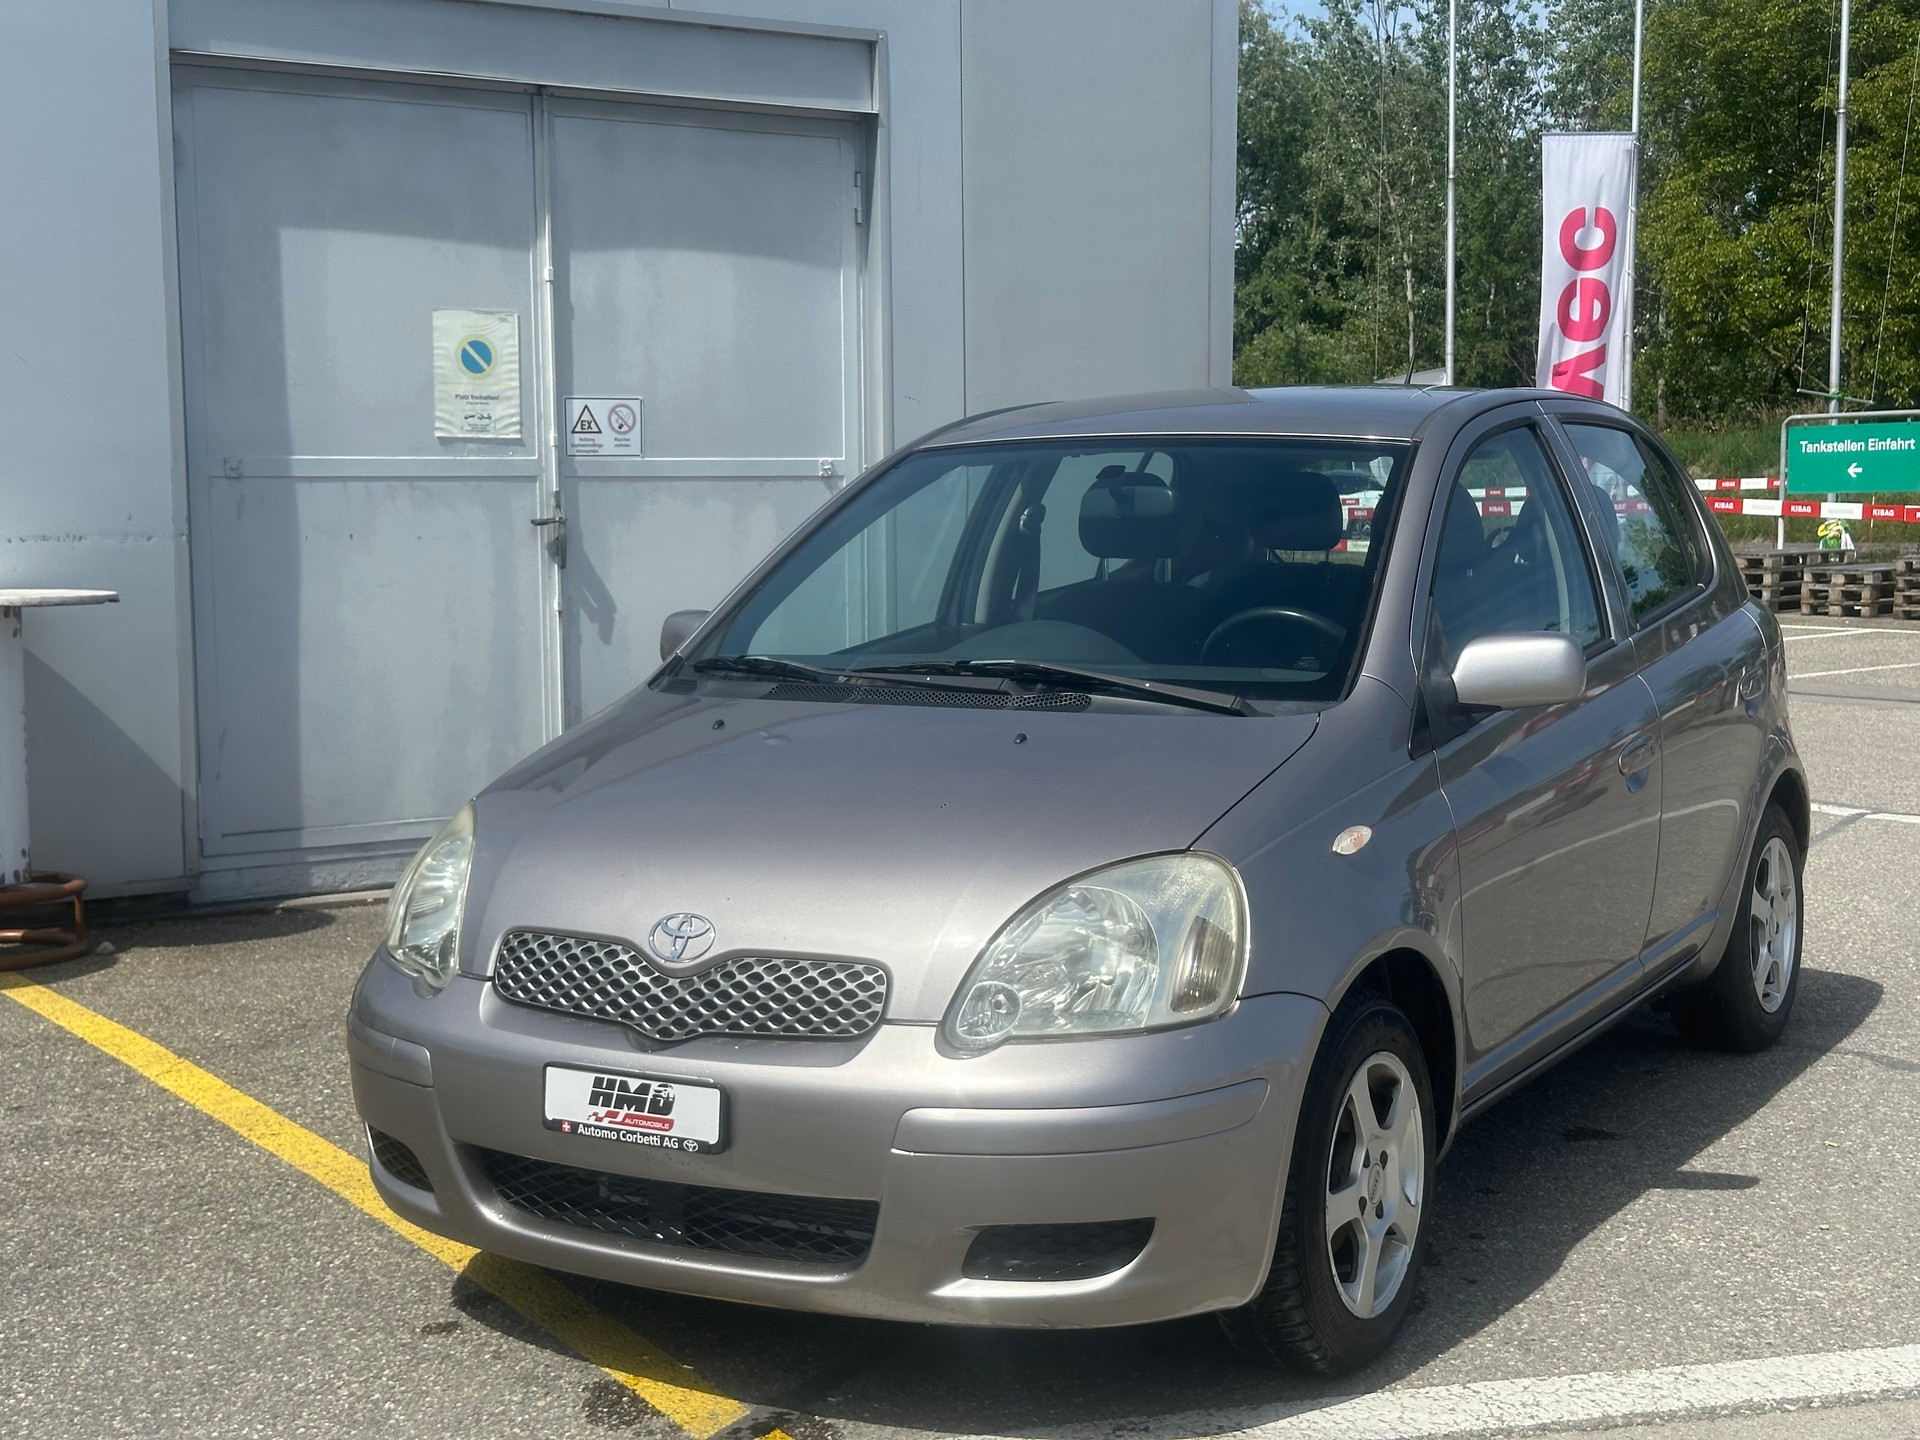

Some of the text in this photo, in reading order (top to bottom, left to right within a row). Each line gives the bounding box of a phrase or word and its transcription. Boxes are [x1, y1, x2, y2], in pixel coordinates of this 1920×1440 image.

[580, 420, 593, 430] EX
[1800, 438, 1915, 453] Tankstellen Einfahrt
[1790, 505, 1811, 513] KIBAG
[1872, 508, 1894, 517] KIBAG
[624, 1118, 670, 1129] AUTOMOBILE
[577, 1123, 679, 1149] Automo Corbetti AG
